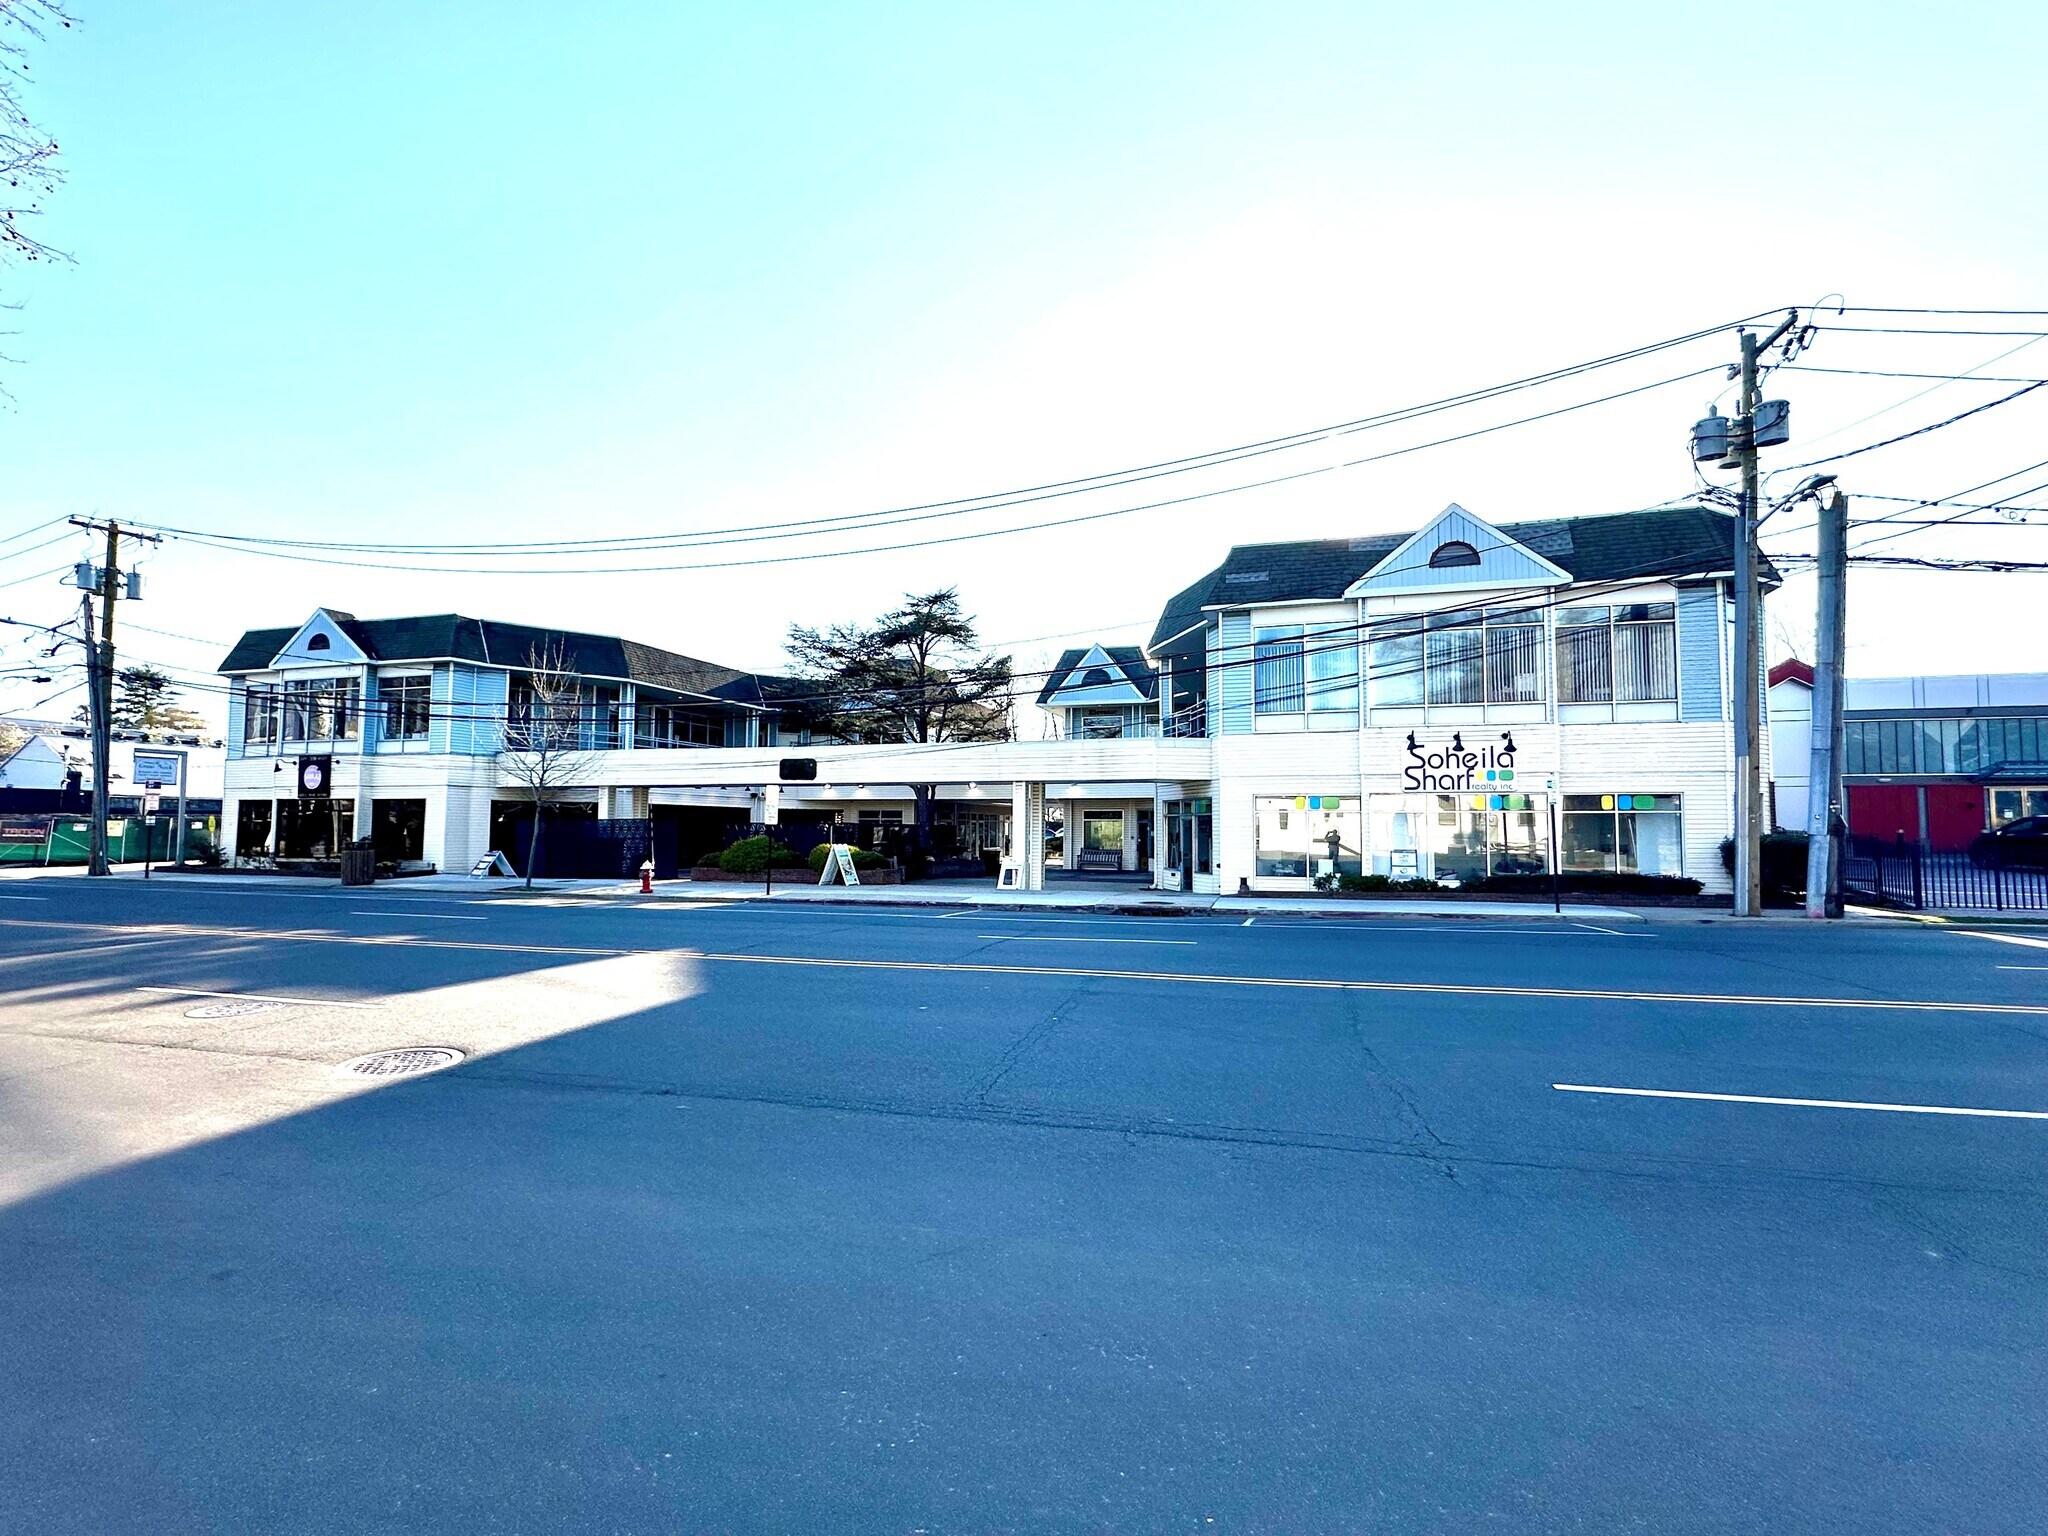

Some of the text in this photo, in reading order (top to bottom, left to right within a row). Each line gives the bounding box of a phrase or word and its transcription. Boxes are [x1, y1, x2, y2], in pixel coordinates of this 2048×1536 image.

[1407, 745, 1514, 769] Soheila
[1404, 766, 1475, 790] Sharf
[1472, 783, 1497, 791] realty
